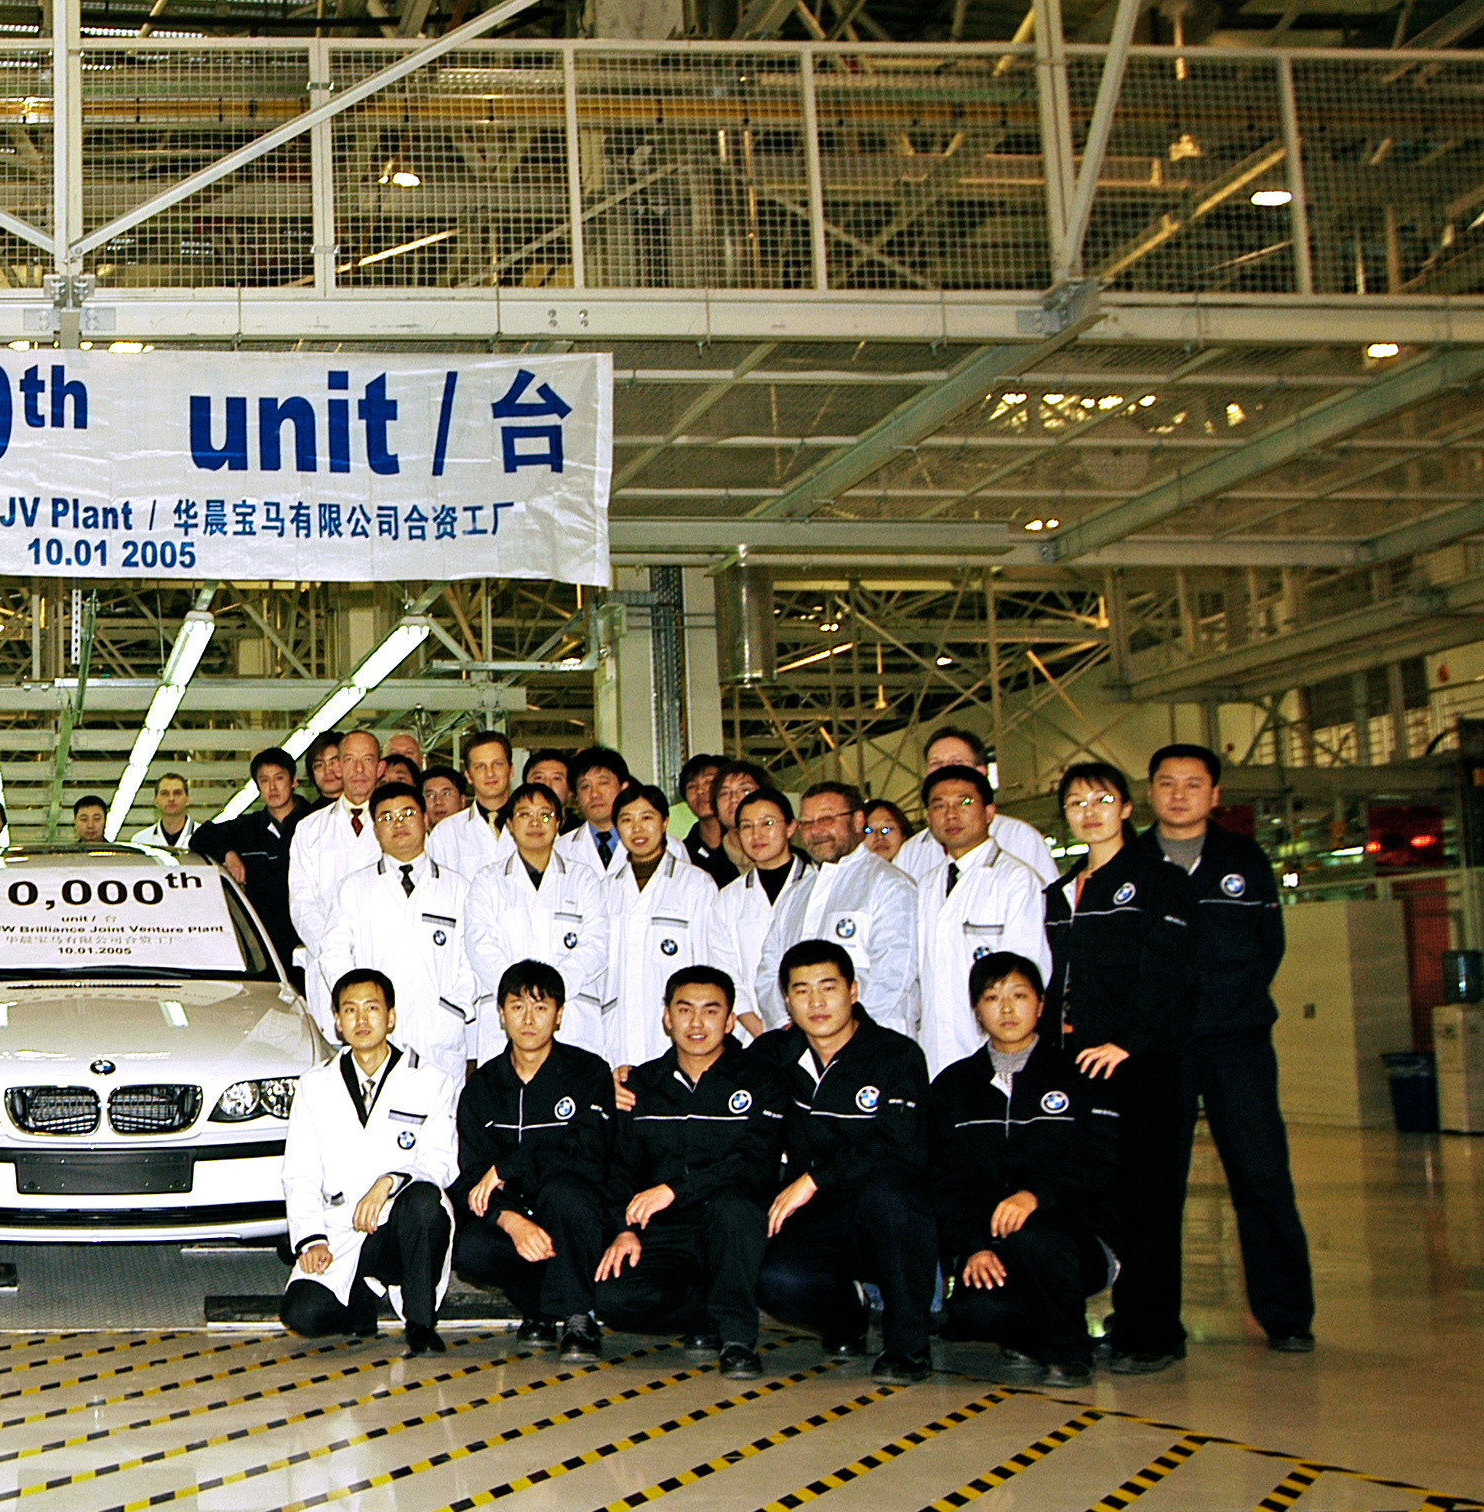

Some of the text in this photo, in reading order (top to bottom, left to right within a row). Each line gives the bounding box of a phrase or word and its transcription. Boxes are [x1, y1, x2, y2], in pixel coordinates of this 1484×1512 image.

[189, 370, 401, 474] unit
[431, 370, 458, 477] /
[491, 369, 573, 474] 台
[0, 496, 41, 527] JV
[51, 497, 134, 530] Plant
[172, 498, 516, 541] 华晨宝马有限公司合资工厂
[27, 537, 196, 569] 10.01 2005
[61, 914, 88, 922] unit
[19, 925, 86, 934] Brilliance
[89, 925, 126, 934] Joint
[129, 925, 185, 934] Venture
[187, 924, 225, 934] Plant
[57, 946, 133, 956] 10.01.2005
